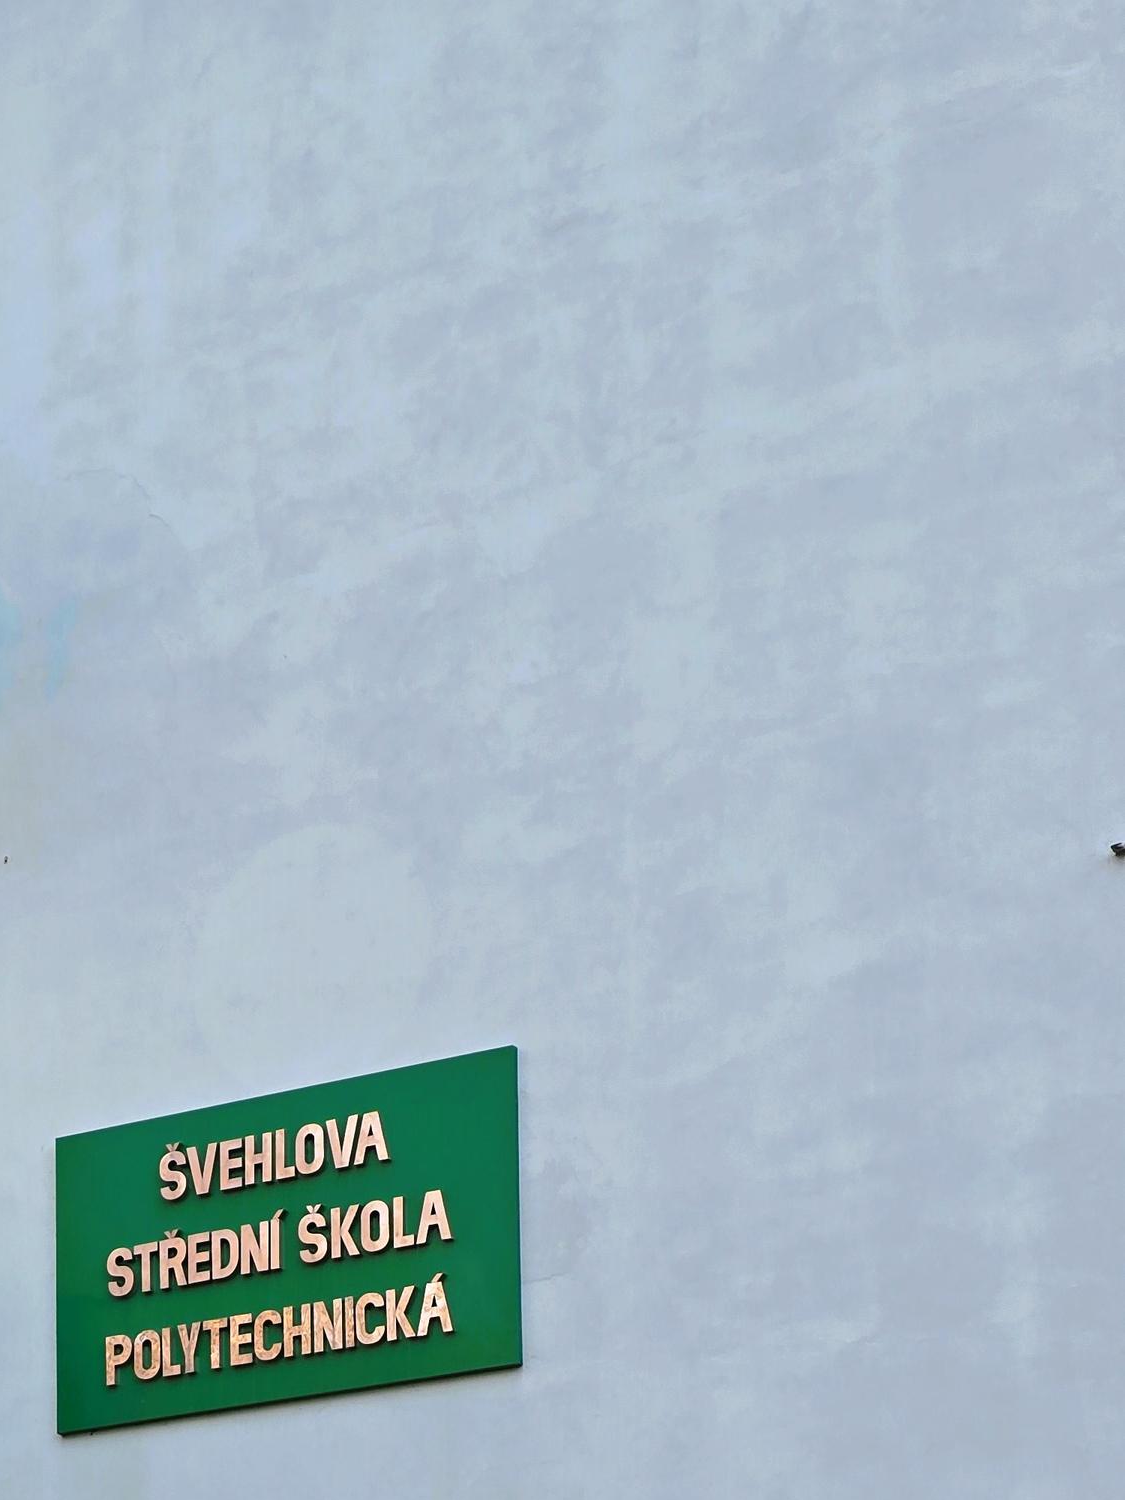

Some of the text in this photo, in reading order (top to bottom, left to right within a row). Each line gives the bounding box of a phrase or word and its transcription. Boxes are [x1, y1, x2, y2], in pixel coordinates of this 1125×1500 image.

[159, 1111, 391, 1201] ŠVEHLOVA
[106, 1189, 453, 1298] STŘEDNÍ ŠKOLA
[105, 1273, 455, 1387] POLYTECHNICKÁ
